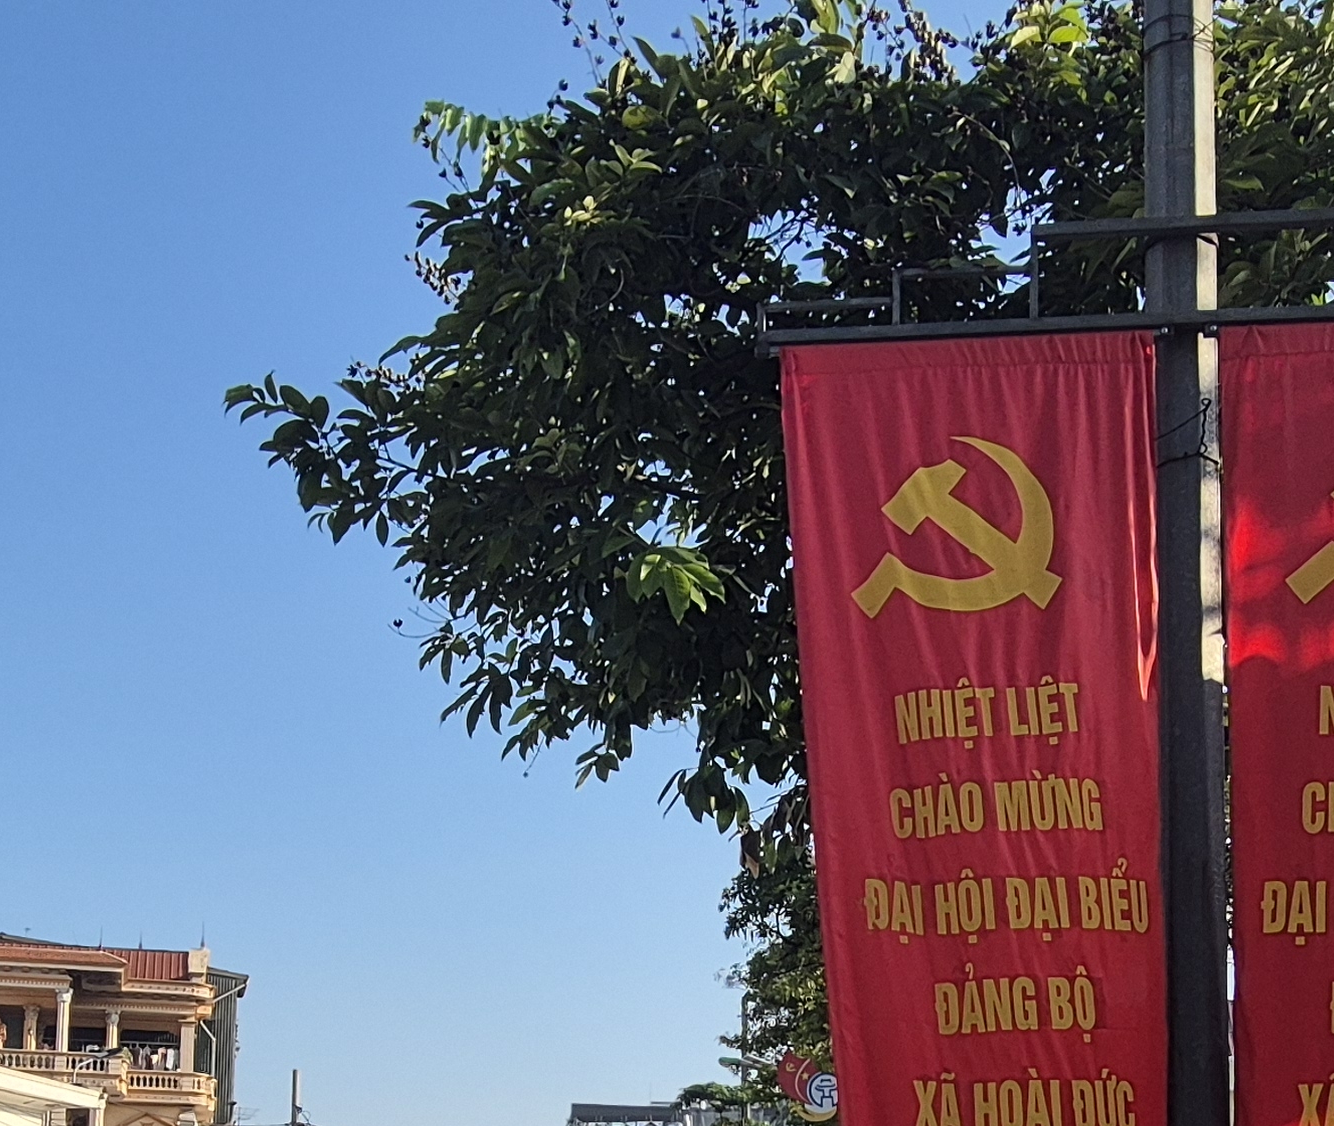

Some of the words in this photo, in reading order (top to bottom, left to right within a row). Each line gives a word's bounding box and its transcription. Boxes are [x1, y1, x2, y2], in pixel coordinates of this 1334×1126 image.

[894, 676, 995, 750] NHIỆT
[1005, 675, 1079, 745] LIỆT
[889, 772, 984, 840] CHÀO
[994, 769, 1104, 832] MỪNG
[864, 877, 924, 945] ĐẠI
[934, 868, 996, 944] HỘI
[1006, 876, 1071, 942] ĐẠI
[1078, 857, 1150, 934] BIỂU
[1261, 880, 1327, 946] ĐẠI
[934, 963, 1039, 1035] ĐẢNG
[1047, 966, 1097, 1043] BỘ
